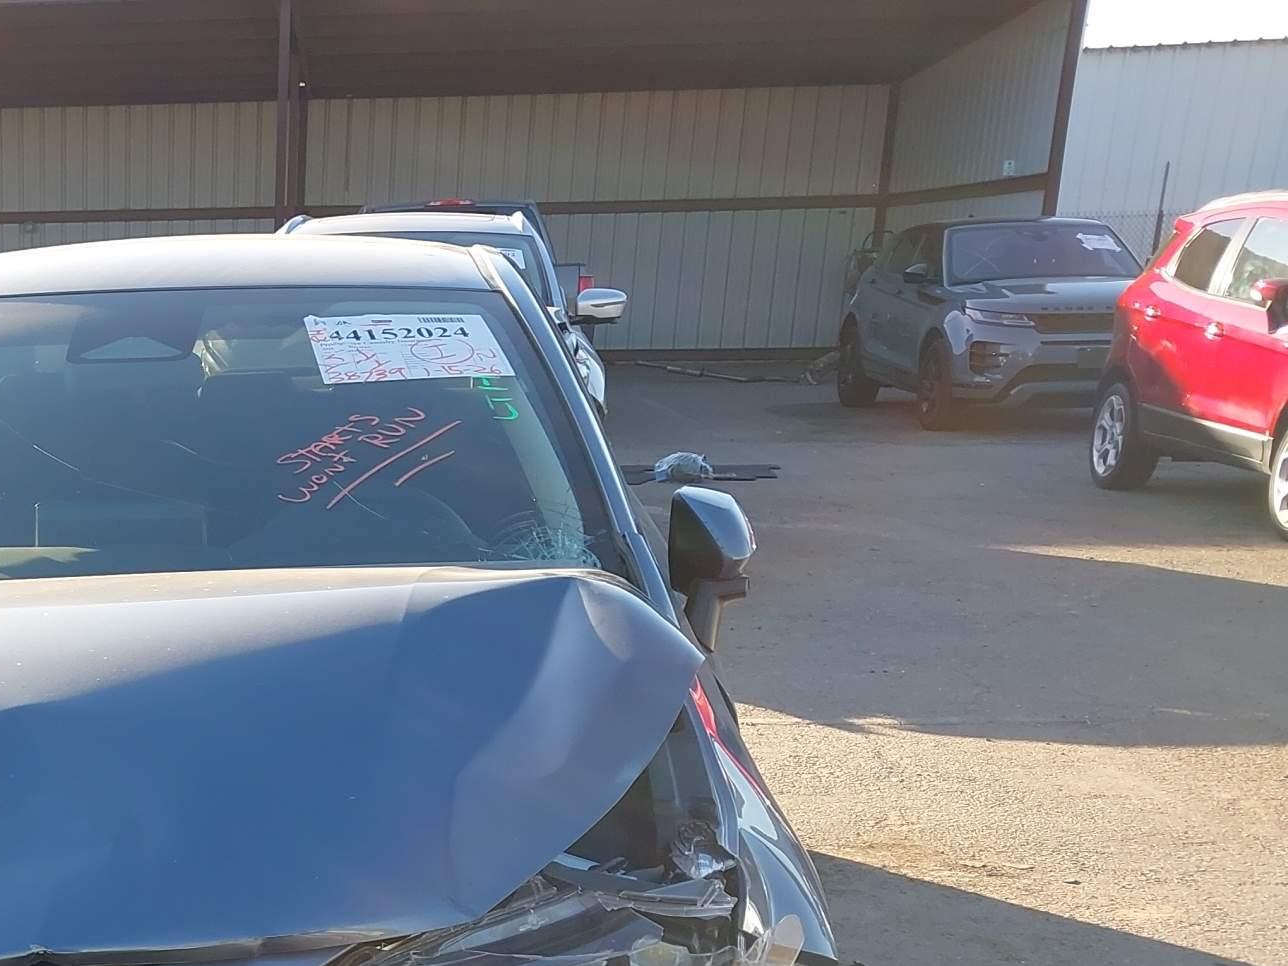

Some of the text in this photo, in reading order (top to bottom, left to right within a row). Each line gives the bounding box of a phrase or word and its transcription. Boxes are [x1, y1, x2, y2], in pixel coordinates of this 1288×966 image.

[329, 326, 470, 342] 44152024
[423, 363, 502, 377] 1-15-26
[358, 407, 426, 448] RUN
[276, 414, 380, 475] STARTS
